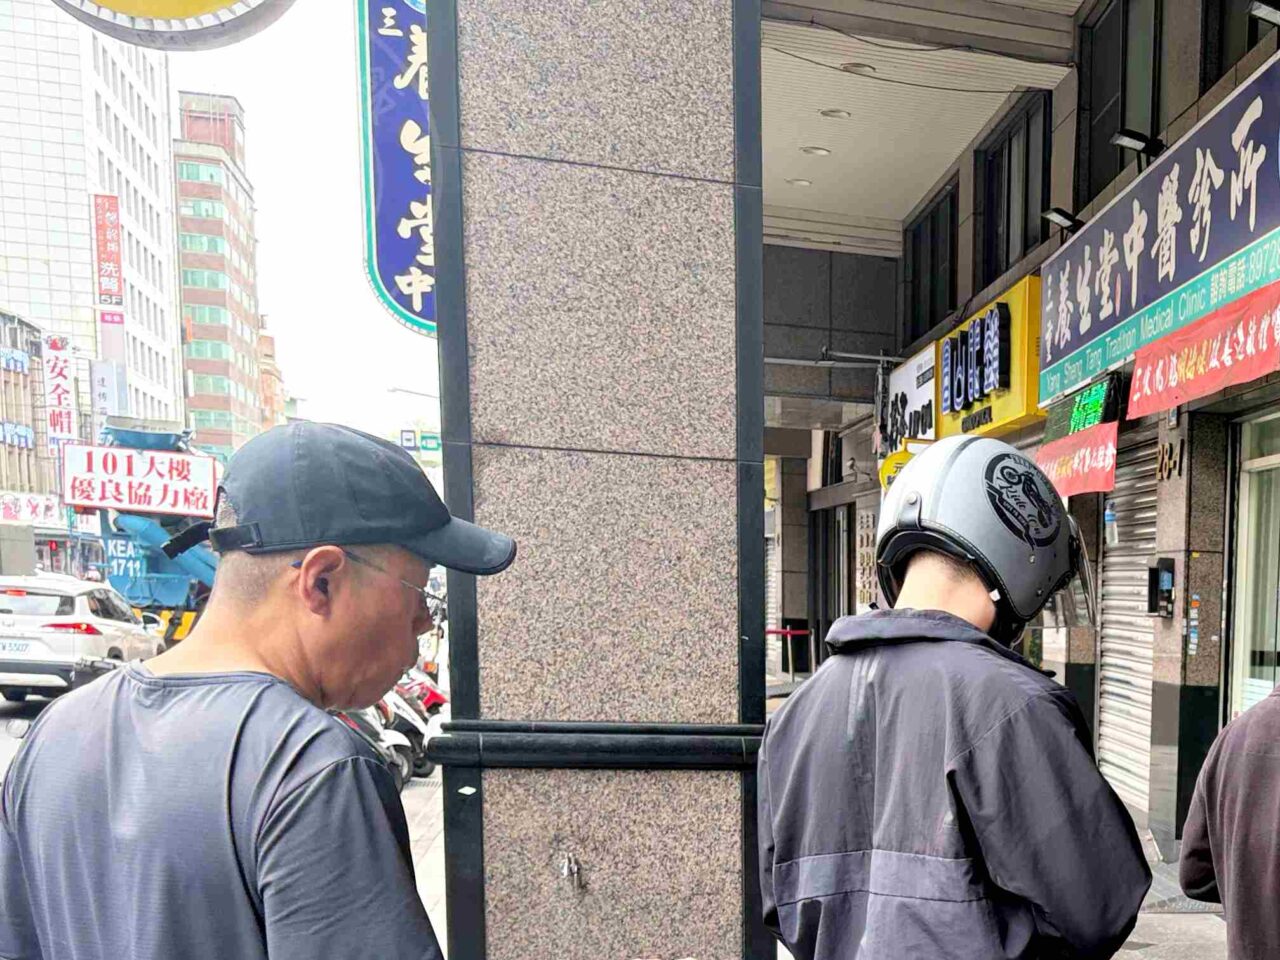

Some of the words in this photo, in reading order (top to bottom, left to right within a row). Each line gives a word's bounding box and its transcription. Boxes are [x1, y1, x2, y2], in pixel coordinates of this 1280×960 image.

[1140, 306, 1174, 340] Medical
[1178, 287, 1207, 319] Clinic
[84, 451, 192, 482] 101大樓
[70, 476, 209, 511] 優良協力廠
